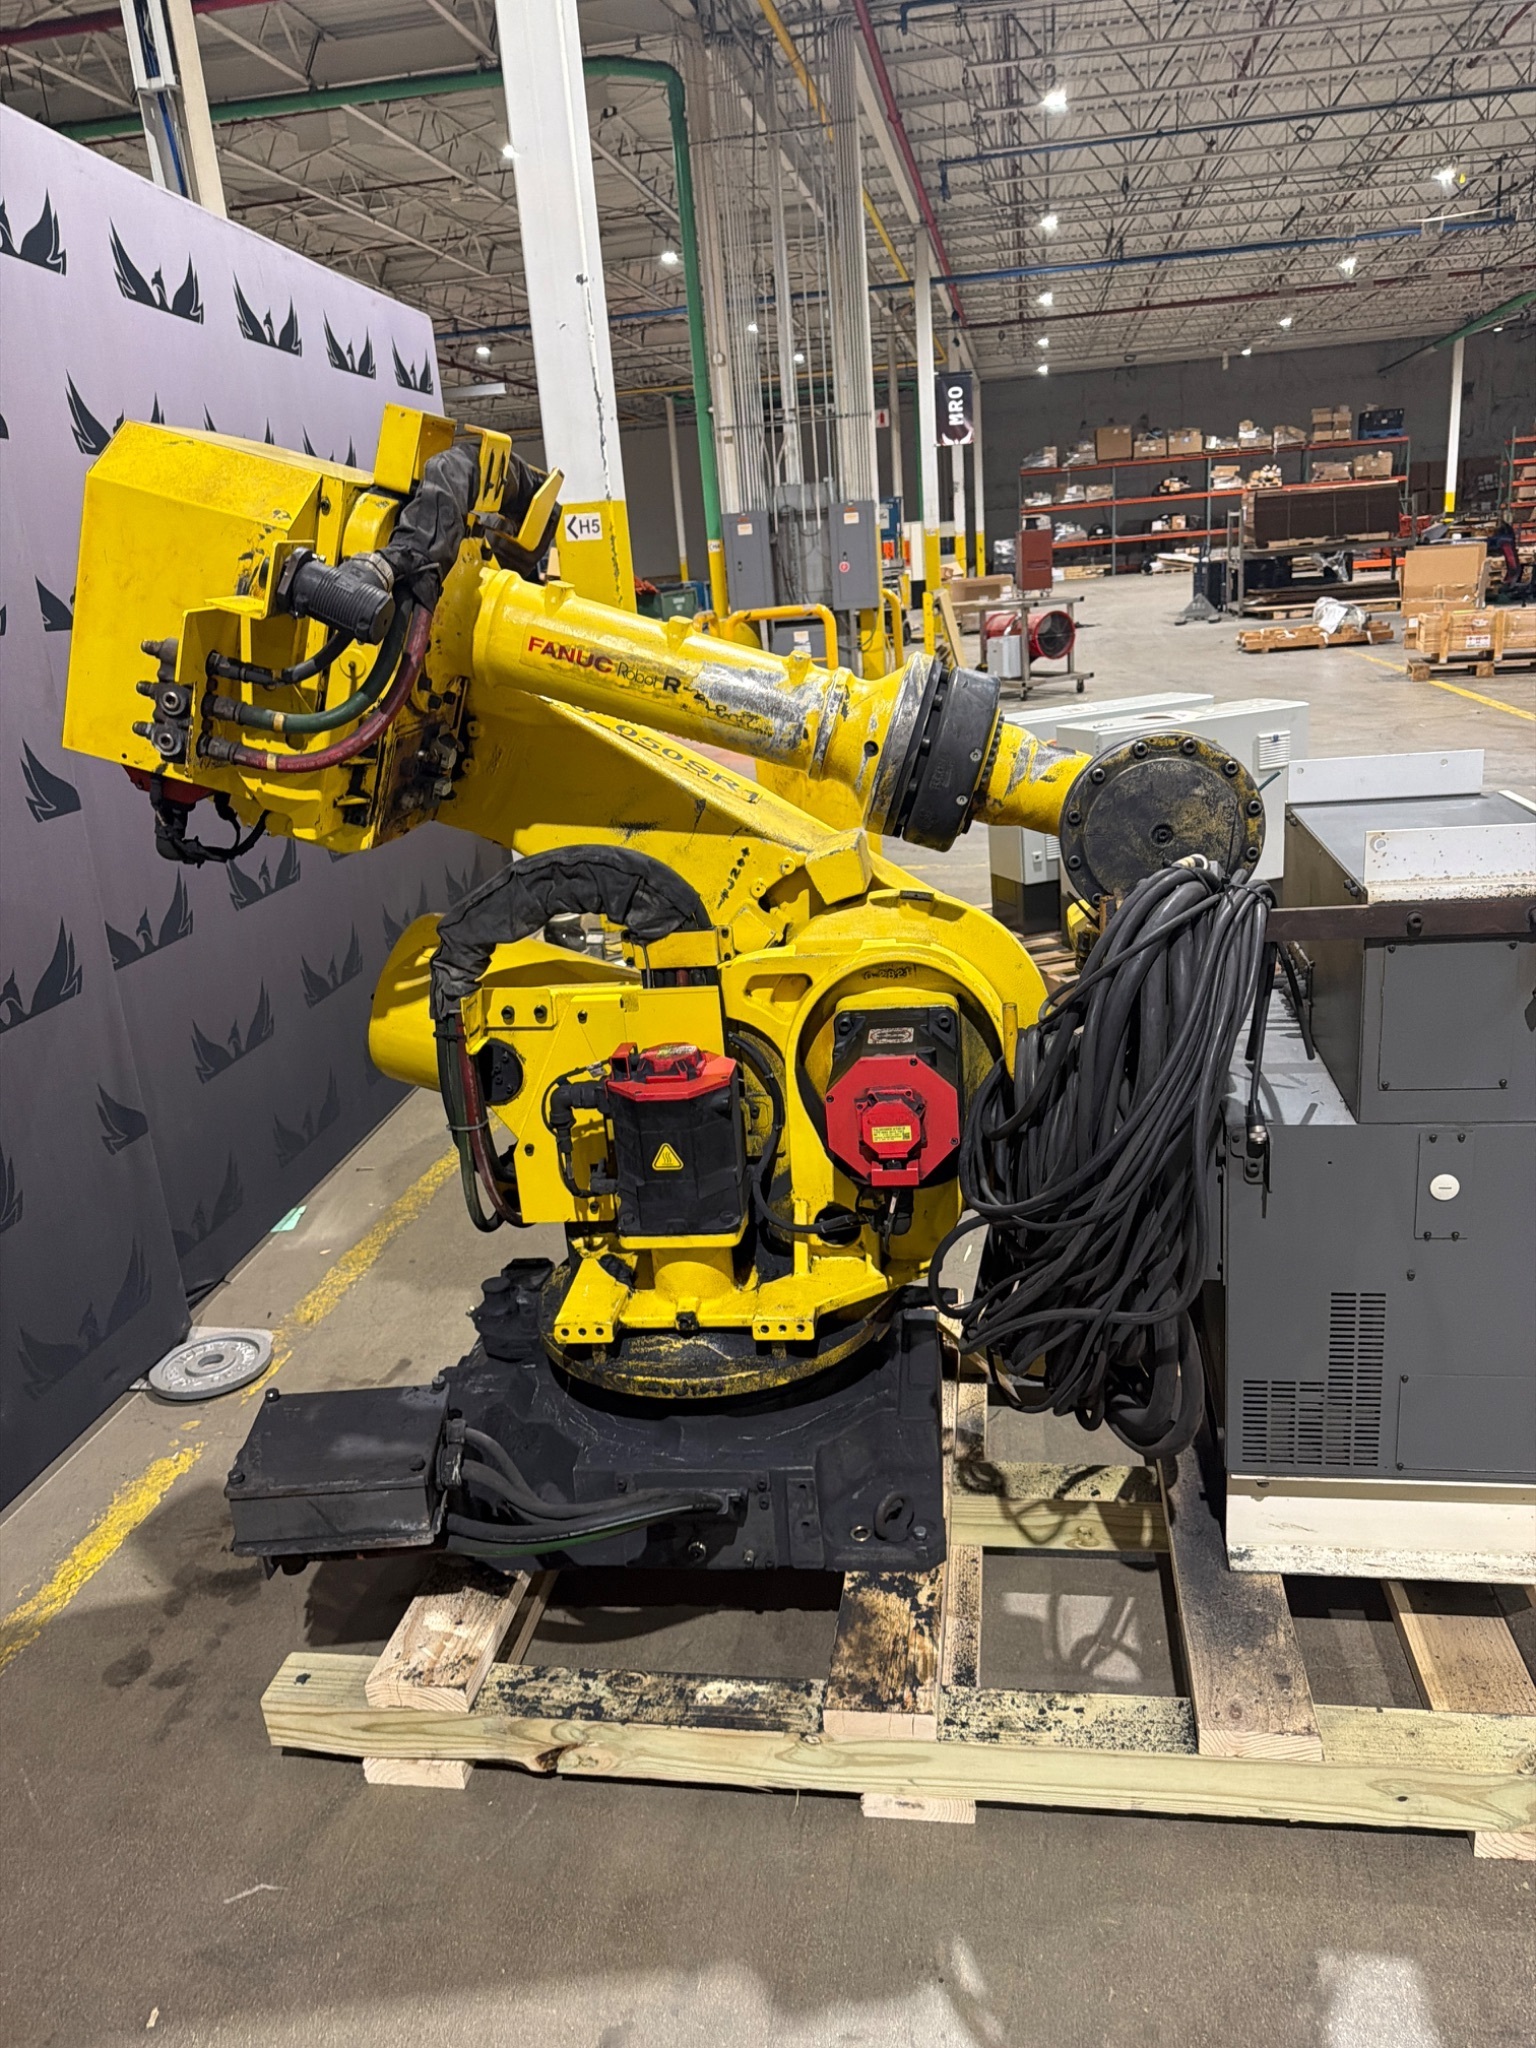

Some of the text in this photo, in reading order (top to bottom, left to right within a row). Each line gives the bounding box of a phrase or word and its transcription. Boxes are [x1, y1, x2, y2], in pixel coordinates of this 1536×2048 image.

[948, 386, 964, 426] MRO
[578, 518, 600, 534] H5
[528, 636, 613, 673] FANUC
[617, 662, 657, 687] Robot
